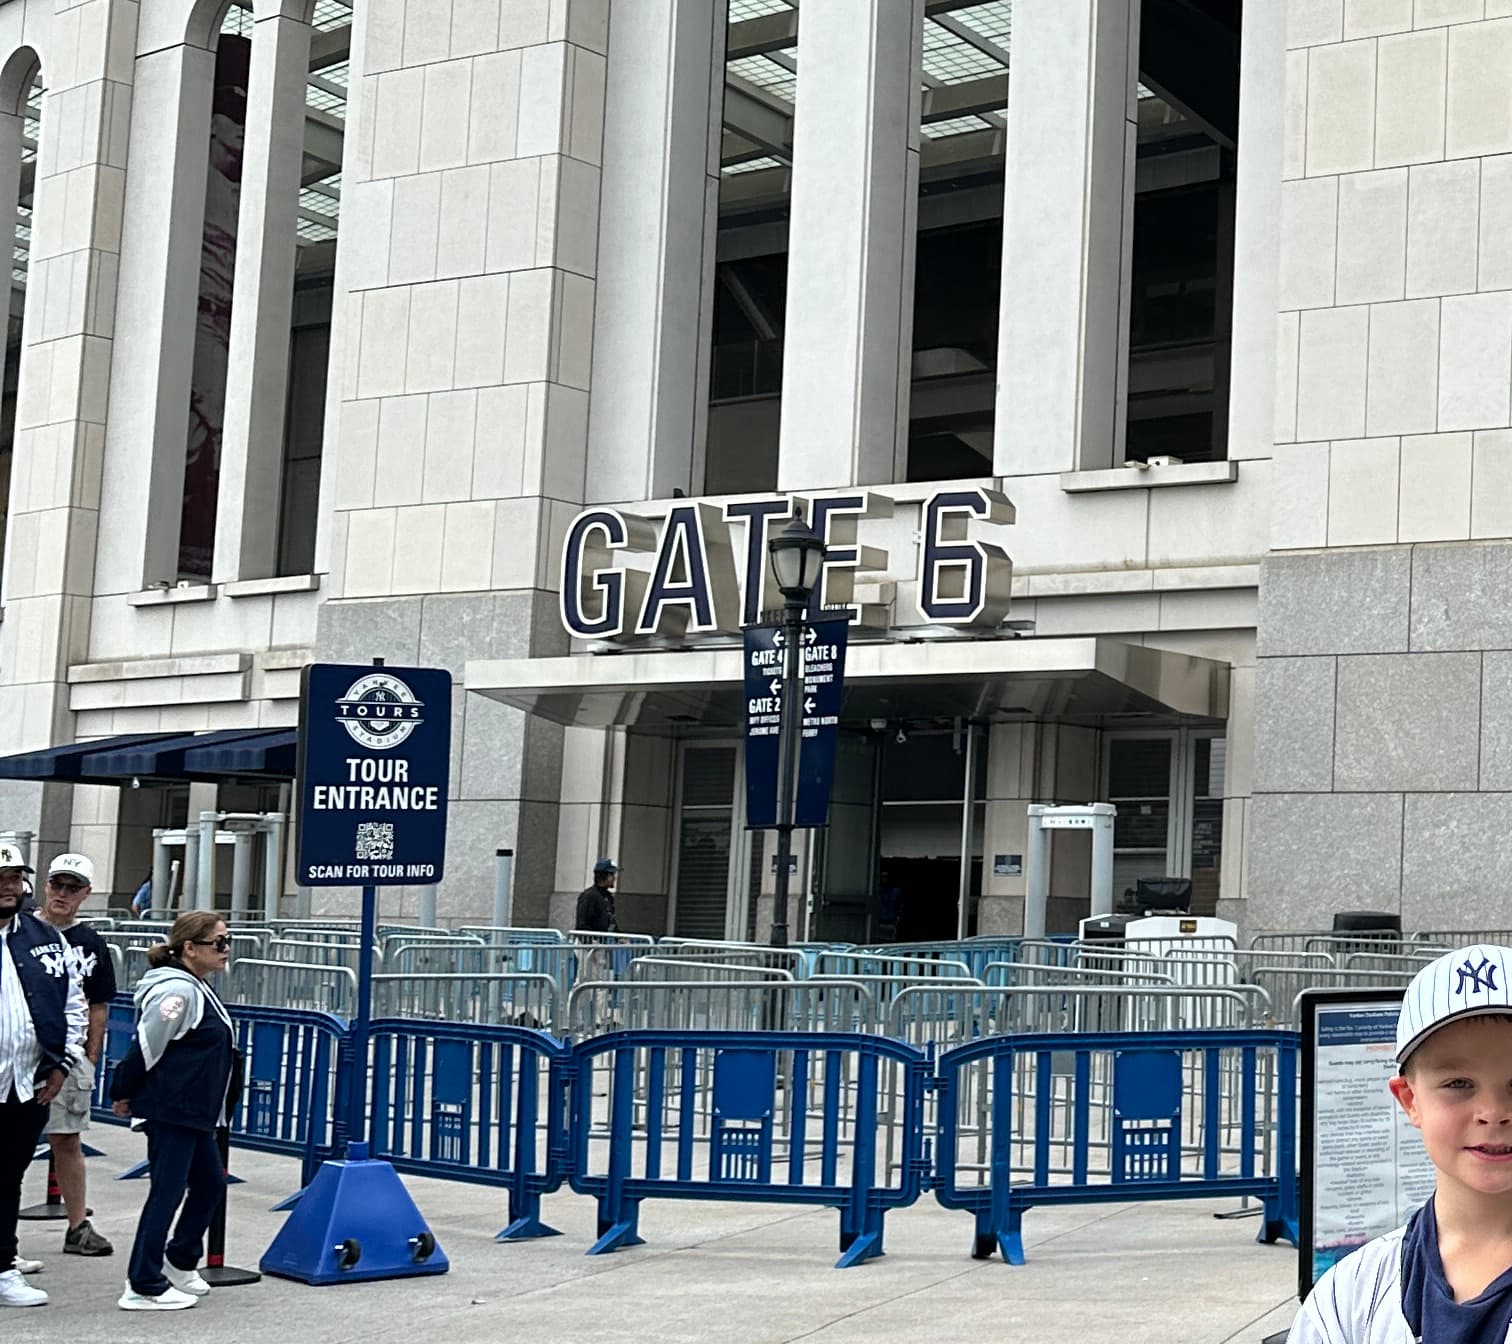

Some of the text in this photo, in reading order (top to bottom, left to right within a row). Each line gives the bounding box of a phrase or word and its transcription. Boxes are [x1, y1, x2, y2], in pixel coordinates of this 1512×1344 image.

[560, 488, 992, 640] GATE 6
[751, 648, 783, 666] GATE 4
[805, 644, 838, 662] GATE 8
[340, 705, 419, 718] TOURS
[749, 697, 781, 714] GATE 2
[353, 725, 408, 745] STADIUM
[346, 758, 409, 782] TOUR
[313, 786, 438, 810] ENTRANCE
[63, 858, 82, 866] NY
[308, 864, 434, 879] SCAN FOR TOUR INFO
[1455, 957, 1498, 995] NY
